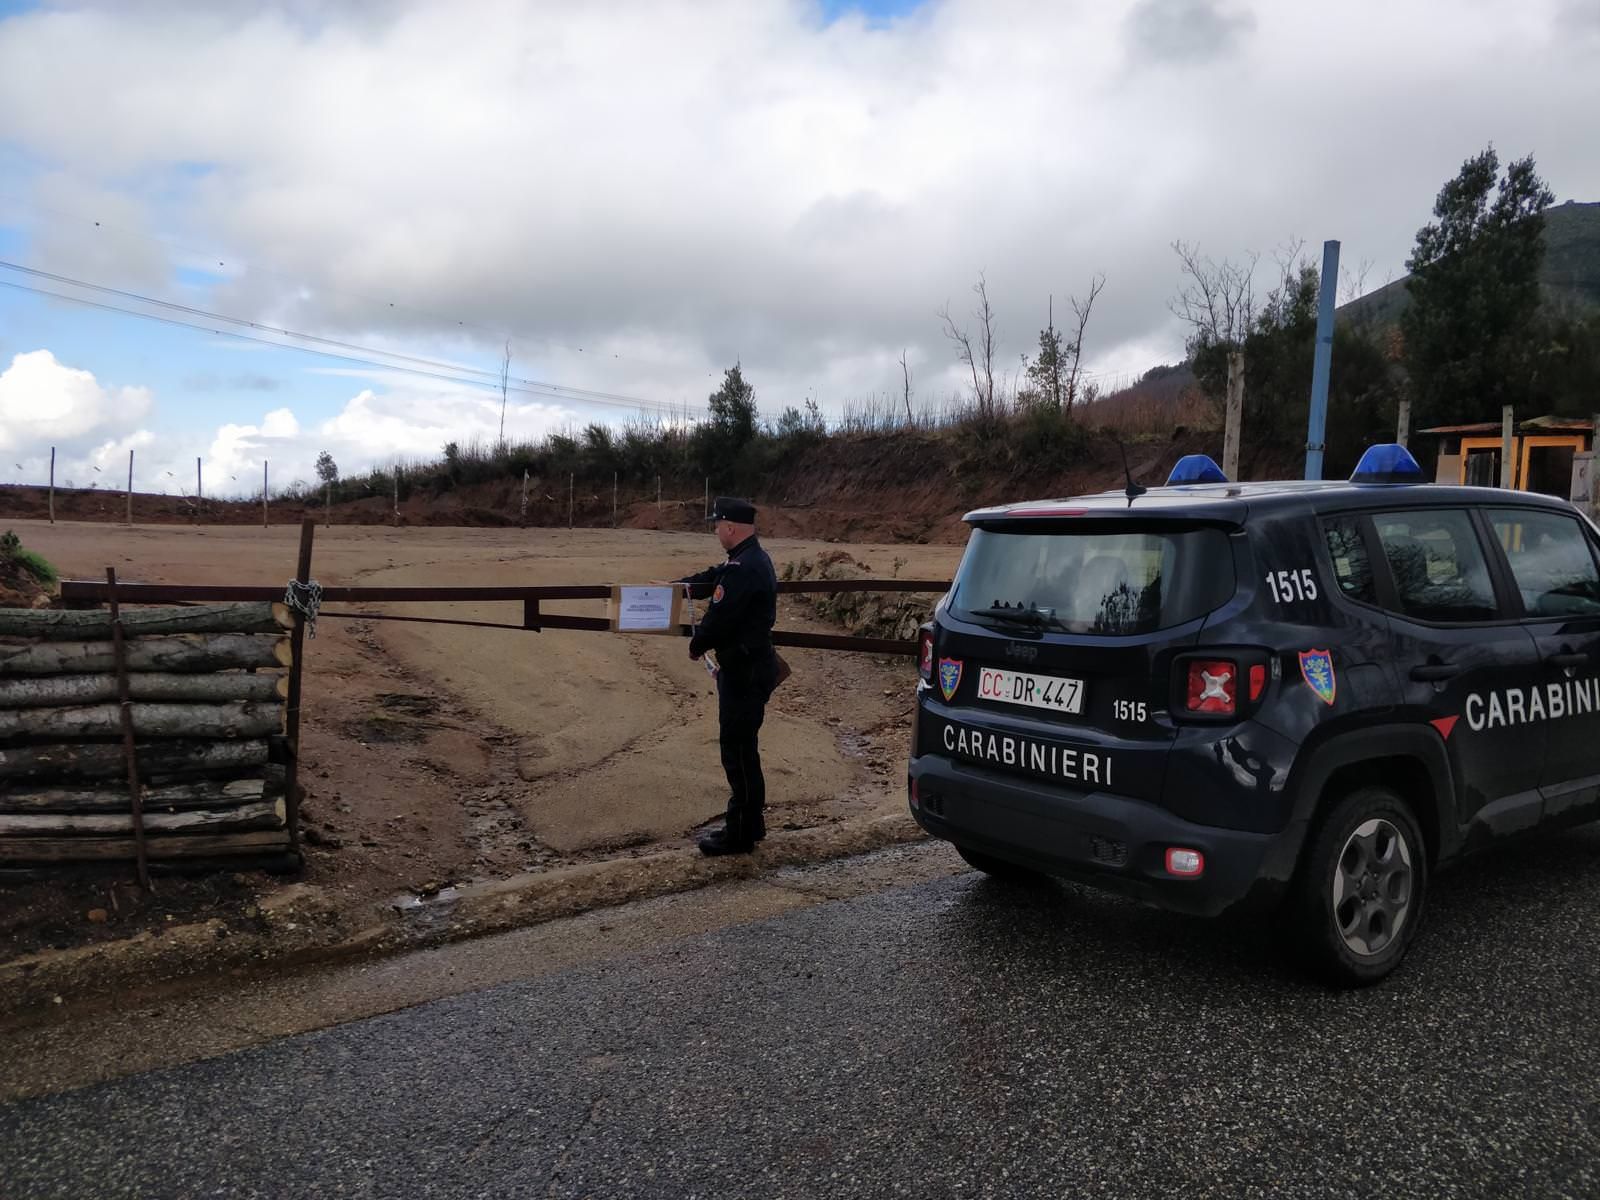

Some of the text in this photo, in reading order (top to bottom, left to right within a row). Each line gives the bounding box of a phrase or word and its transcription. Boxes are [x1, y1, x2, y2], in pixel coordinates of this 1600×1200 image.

[1266, 569, 1317, 603] 1515
[1005, 641, 1038, 662] Jeep
[982, 672, 1079, 709] CC DR 447
[1113, 699, 1147, 722] 1515
[943, 724, 1112, 786] CARABINIERI
